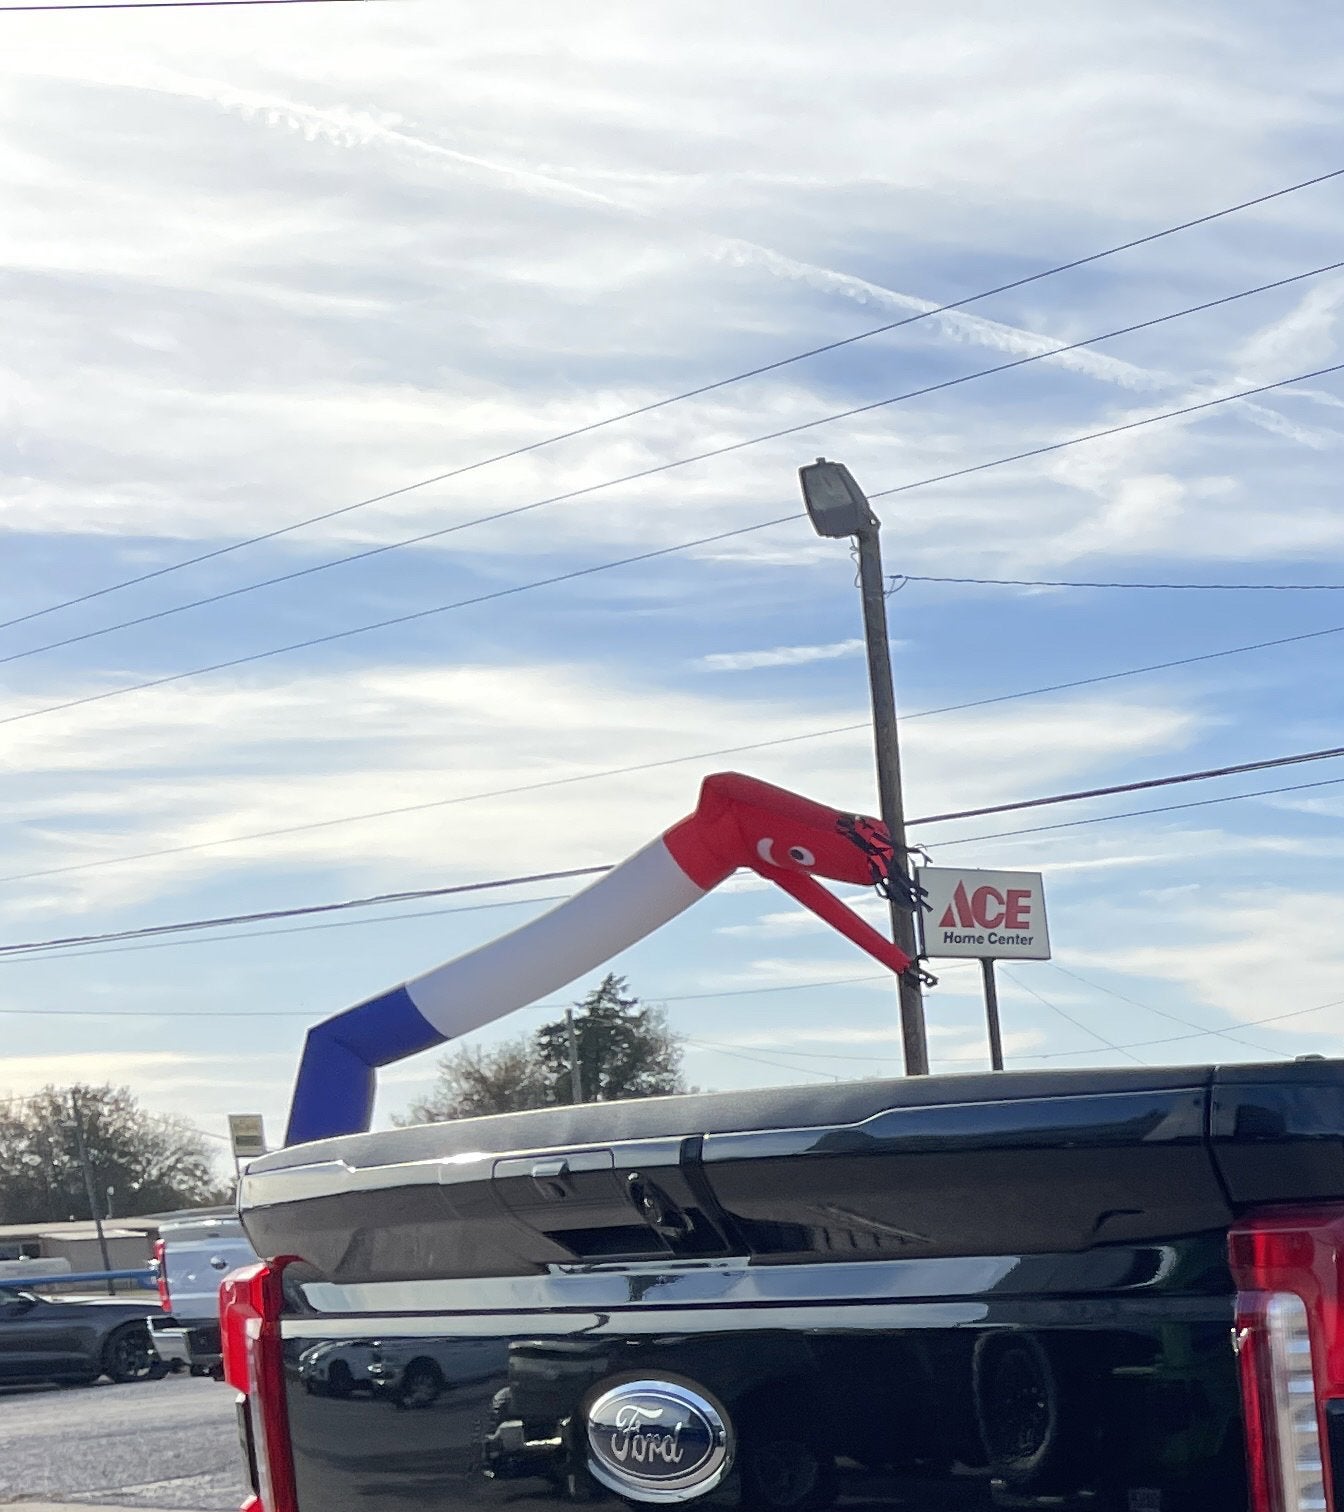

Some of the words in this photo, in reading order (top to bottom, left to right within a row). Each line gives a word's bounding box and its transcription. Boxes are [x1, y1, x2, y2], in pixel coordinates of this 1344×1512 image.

[939, 880, 1032, 930] ACE
[944, 932, 985, 945] Home
[988, 932, 1034, 946] Center
[611, 1404, 684, 1463] Ford
